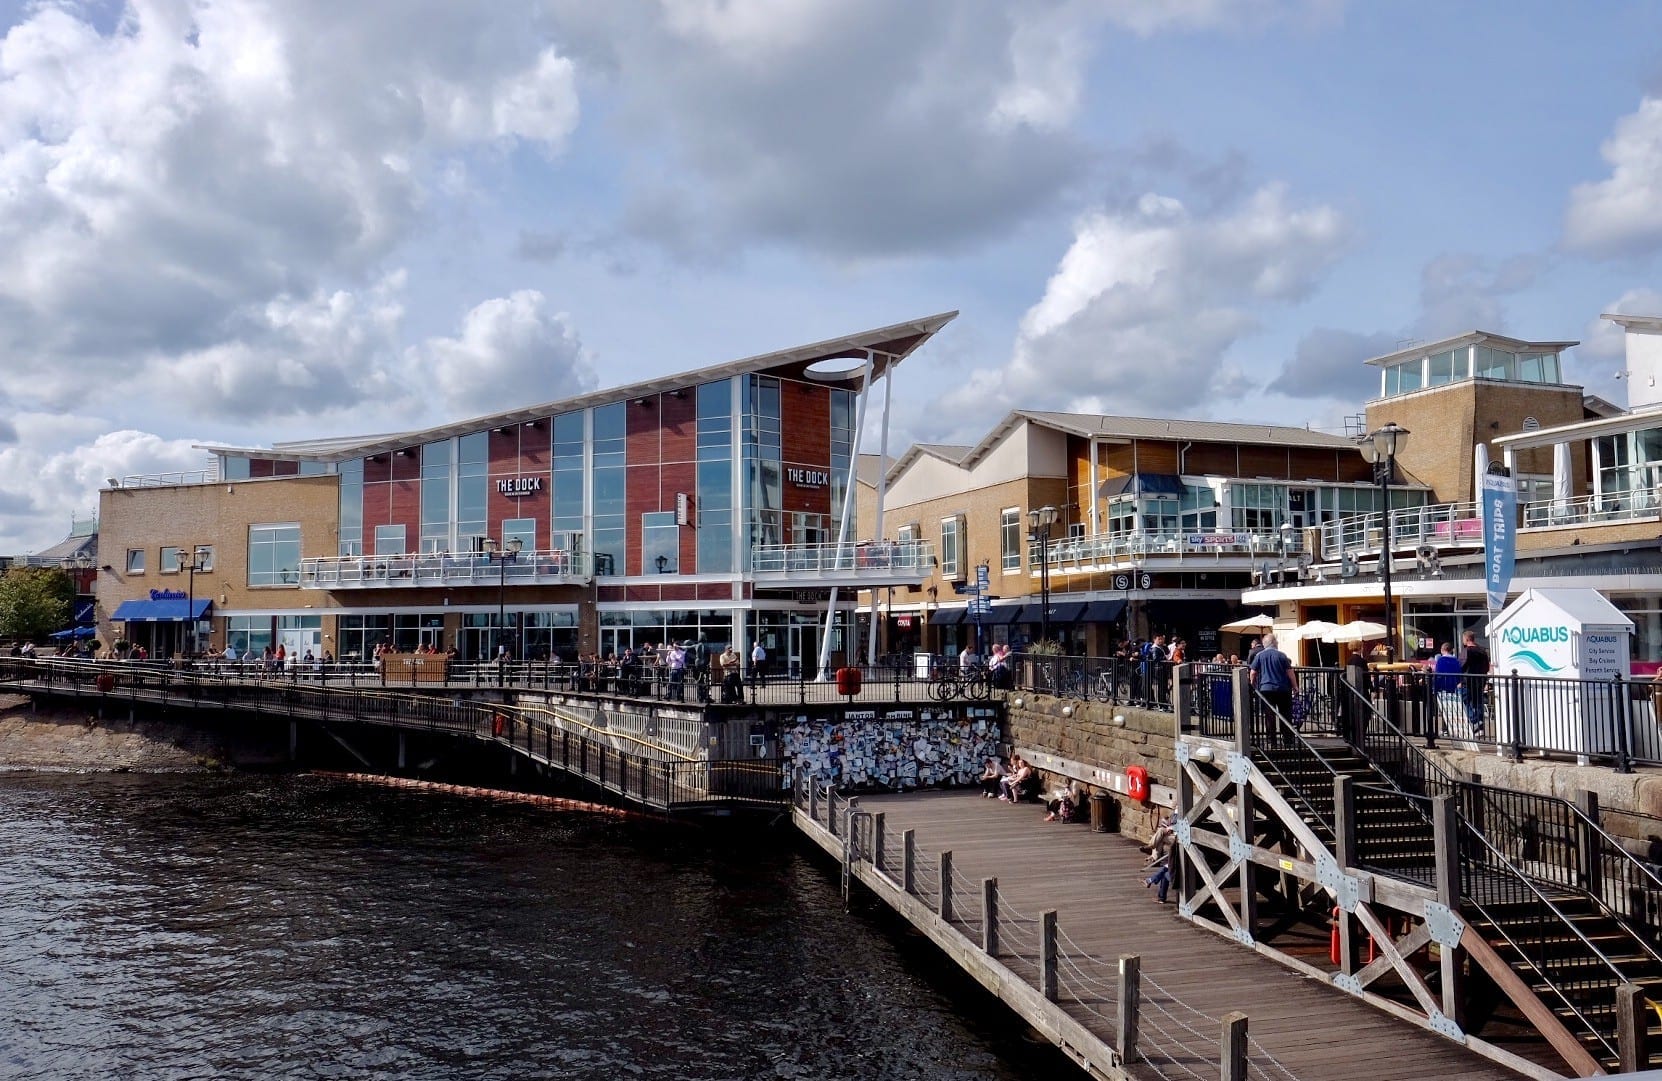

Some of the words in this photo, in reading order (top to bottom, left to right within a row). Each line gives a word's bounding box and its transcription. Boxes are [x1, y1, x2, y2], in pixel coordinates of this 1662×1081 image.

[496, 479, 513, 492] THE
[515, 477, 541, 491] DOCK
[788, 468, 804, 483] THE
[806, 470, 828, 486] DOCK
[1494, 498, 1505, 541] TRIPS
[1492, 546, 1503, 584] BOAT
[1502, 626, 1569, 645] AQUABUS
[1586, 635, 1617, 643] AQUABUS
